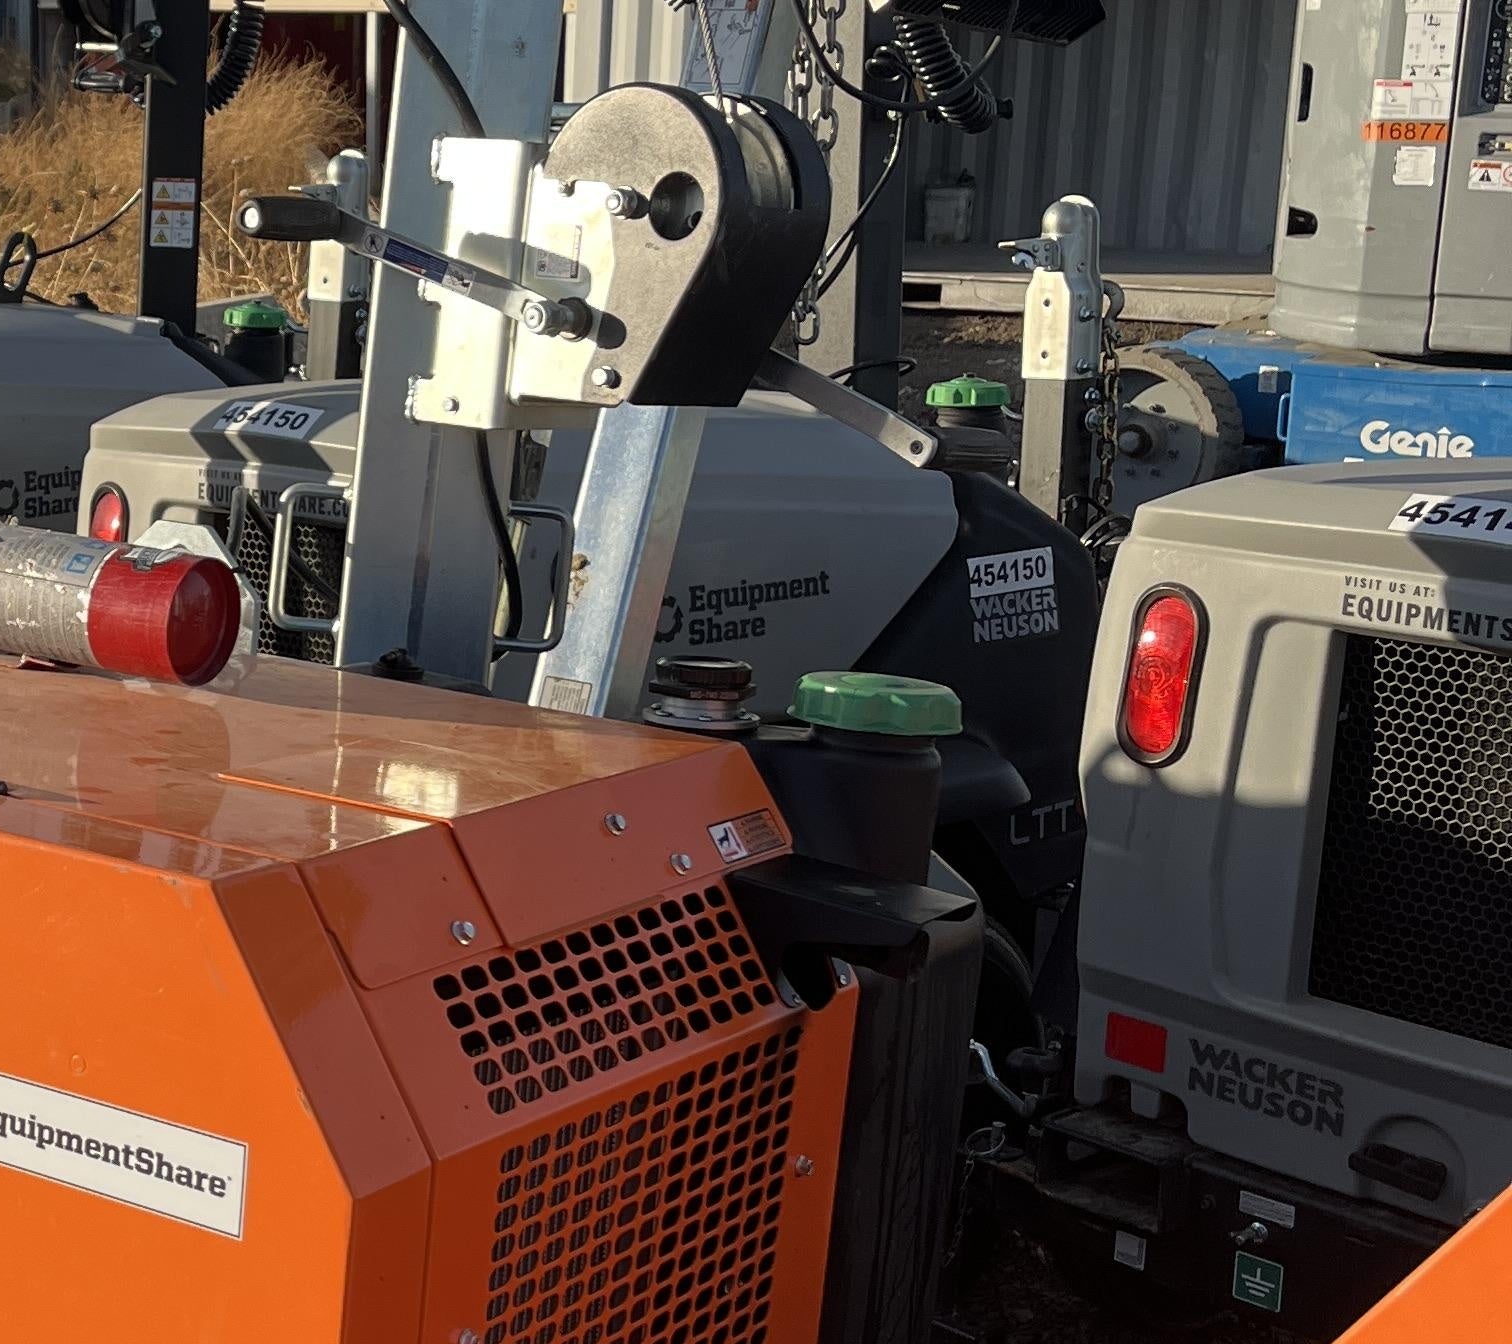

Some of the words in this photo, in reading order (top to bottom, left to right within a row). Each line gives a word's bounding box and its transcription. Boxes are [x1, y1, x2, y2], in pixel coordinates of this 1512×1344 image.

[1364, 122, 1447, 140] 116877
[221, 406, 310, 431] 454150
[1360, 420, 1474, 459] Genie
[969, 555, 1046, 587] 454150
[1344, 575, 1382, 591] VISIT
[1388, 581, 1407, 594] US
[1413, 586, 1435, 597] AT:
[689, 570, 830, 615] Equipment
[969, 588, 1056, 619] WACKER
[689, 616, 766, 646] Share
[973, 609, 1059, 643] NEUSON
[1189, 1038, 1344, 1109] WACKER
[1188, 1066, 1344, 1137] NEUSON
